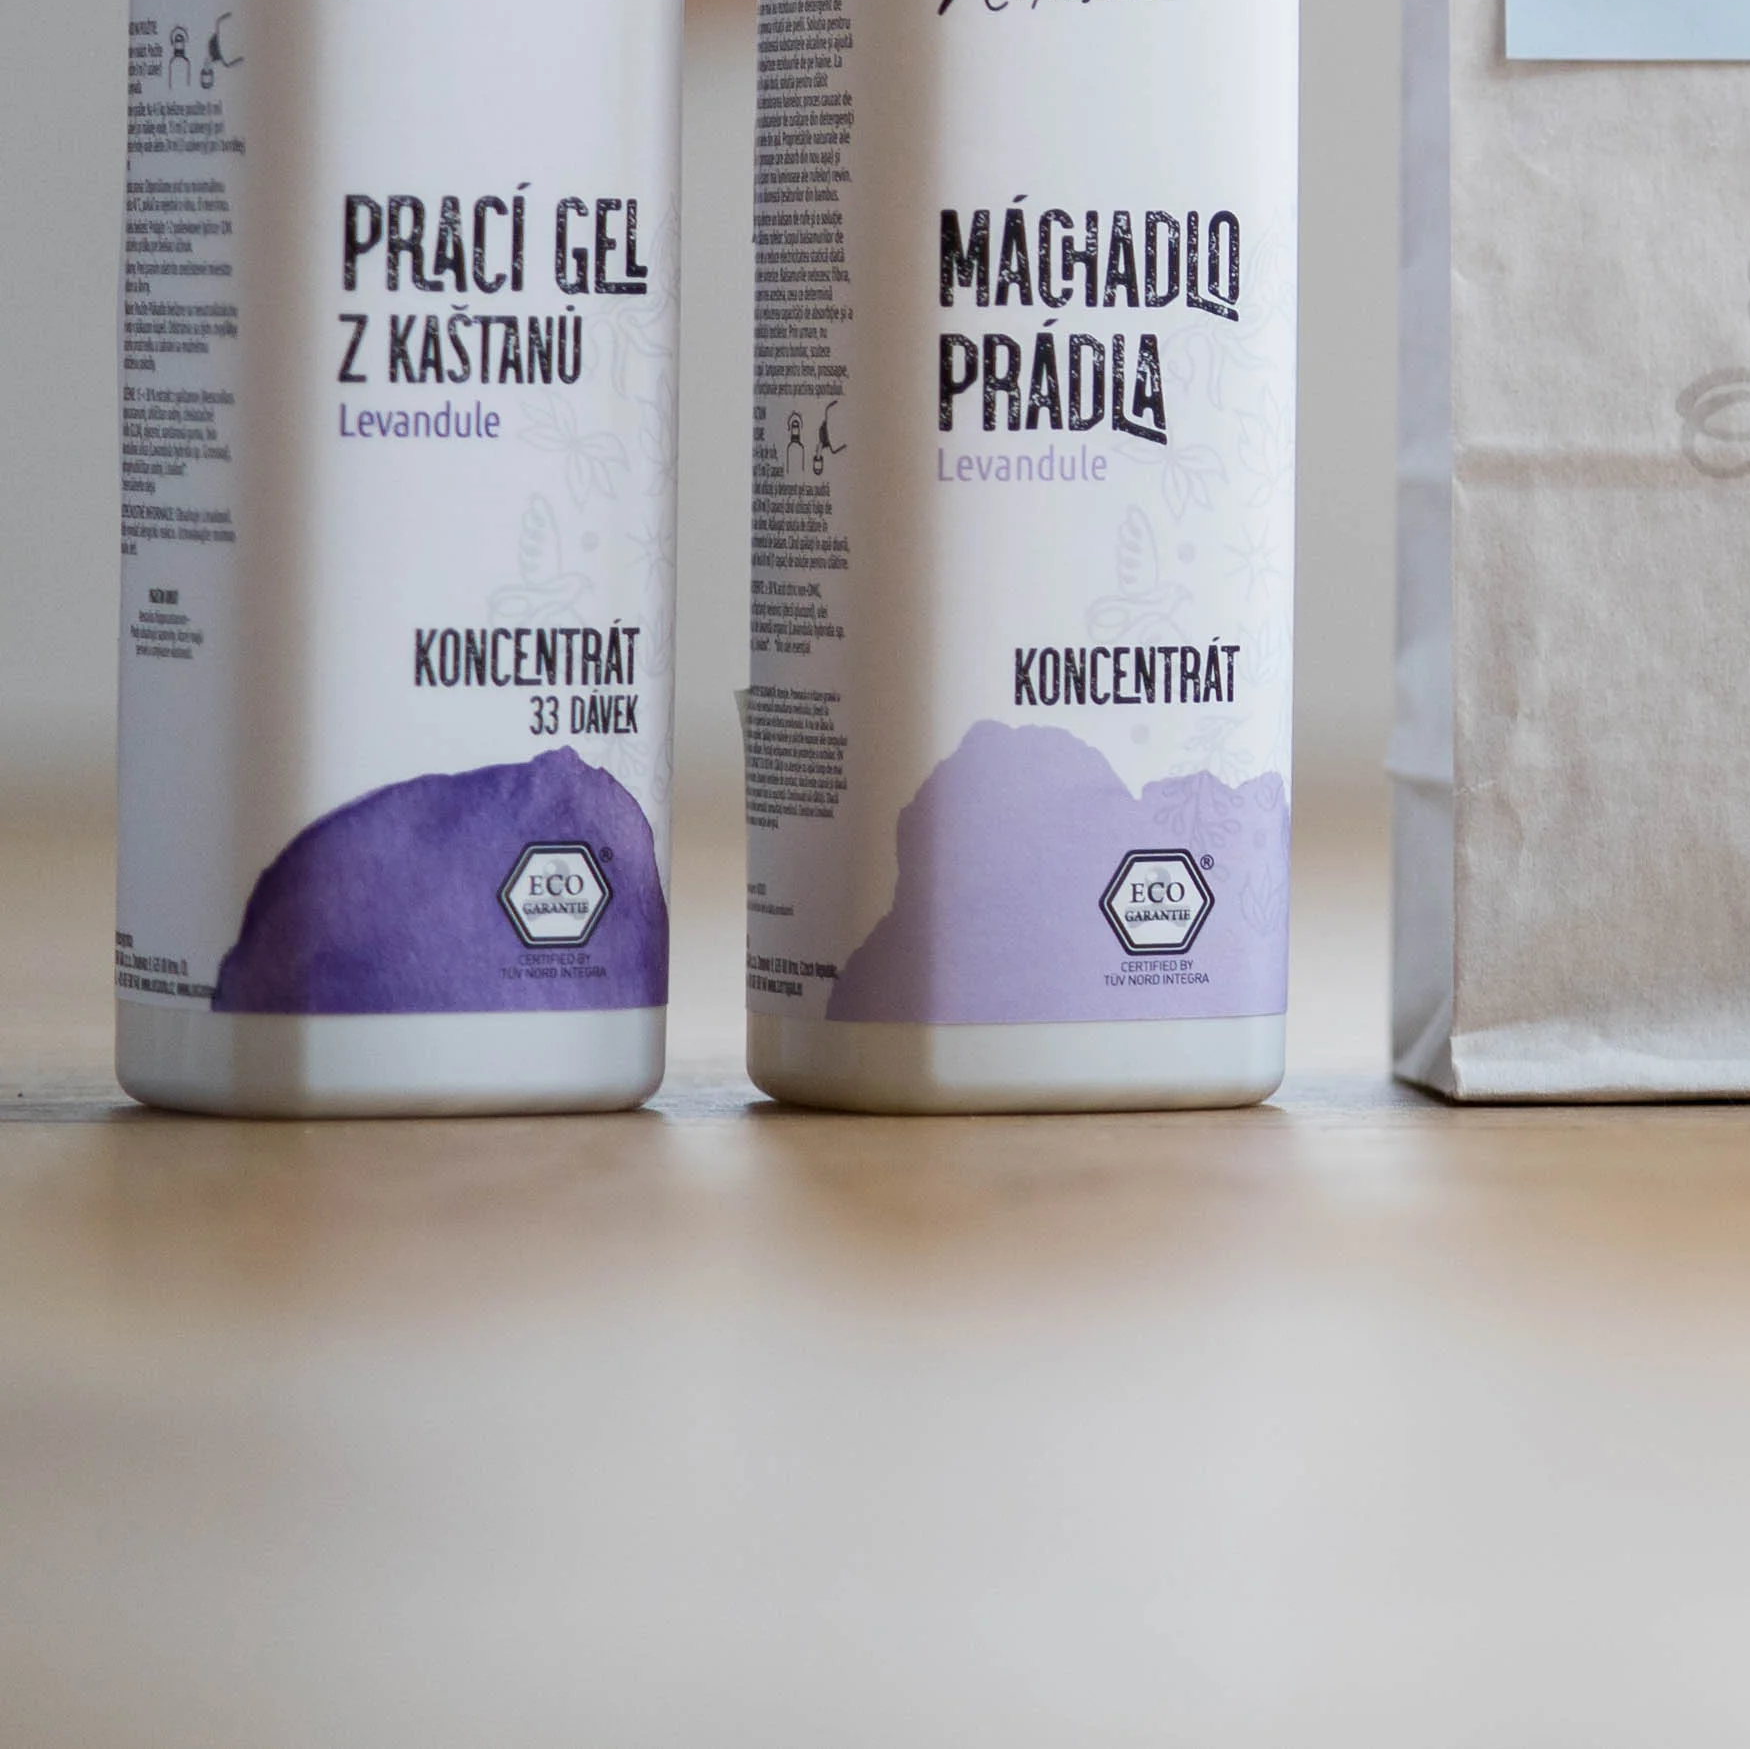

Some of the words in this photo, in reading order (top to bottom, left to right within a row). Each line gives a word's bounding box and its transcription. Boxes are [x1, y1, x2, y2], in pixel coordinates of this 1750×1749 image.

[343, 183, 529, 294] PRACÍ
[555, 197, 649, 295] GEL
[939, 195, 1240, 323] MÁCHADLO
[338, 314, 368, 383] Z
[389, 304, 583, 385] KAŠTANŮ
[938, 318, 1168, 446] PRÁDLA
[339, 401, 501, 439] Levandule
[937, 445, 1108, 483] Levandule
[415, 618, 640, 687] KONCENTRÁT
[1015, 637, 1241, 706] KONCENTRÁT
[530, 696, 559, 736] 33
[571, 690, 639, 735] DÁVEK
[529, 874, 584, 896] ECO
[1130, 882, 1185, 903] ECO
[523, 901, 589, 914] GARANTIE
[1125, 910, 1191, 922] GARANTIE
[518, 953, 575, 966] CERTIFIED
[577, 953, 591, 965] BY
[525, 967, 557, 979] NORD
[560, 966, 606, 979] INTEGRA
[1121, 961, 1177, 973] CERTIFIED
[1180, 960, 1194, 971] BY
[1104, 973, 1125, 986] TÜV
[1128, 974, 1160, 986] NORD
[1163, 972, 1209, 985] INTEGRA
